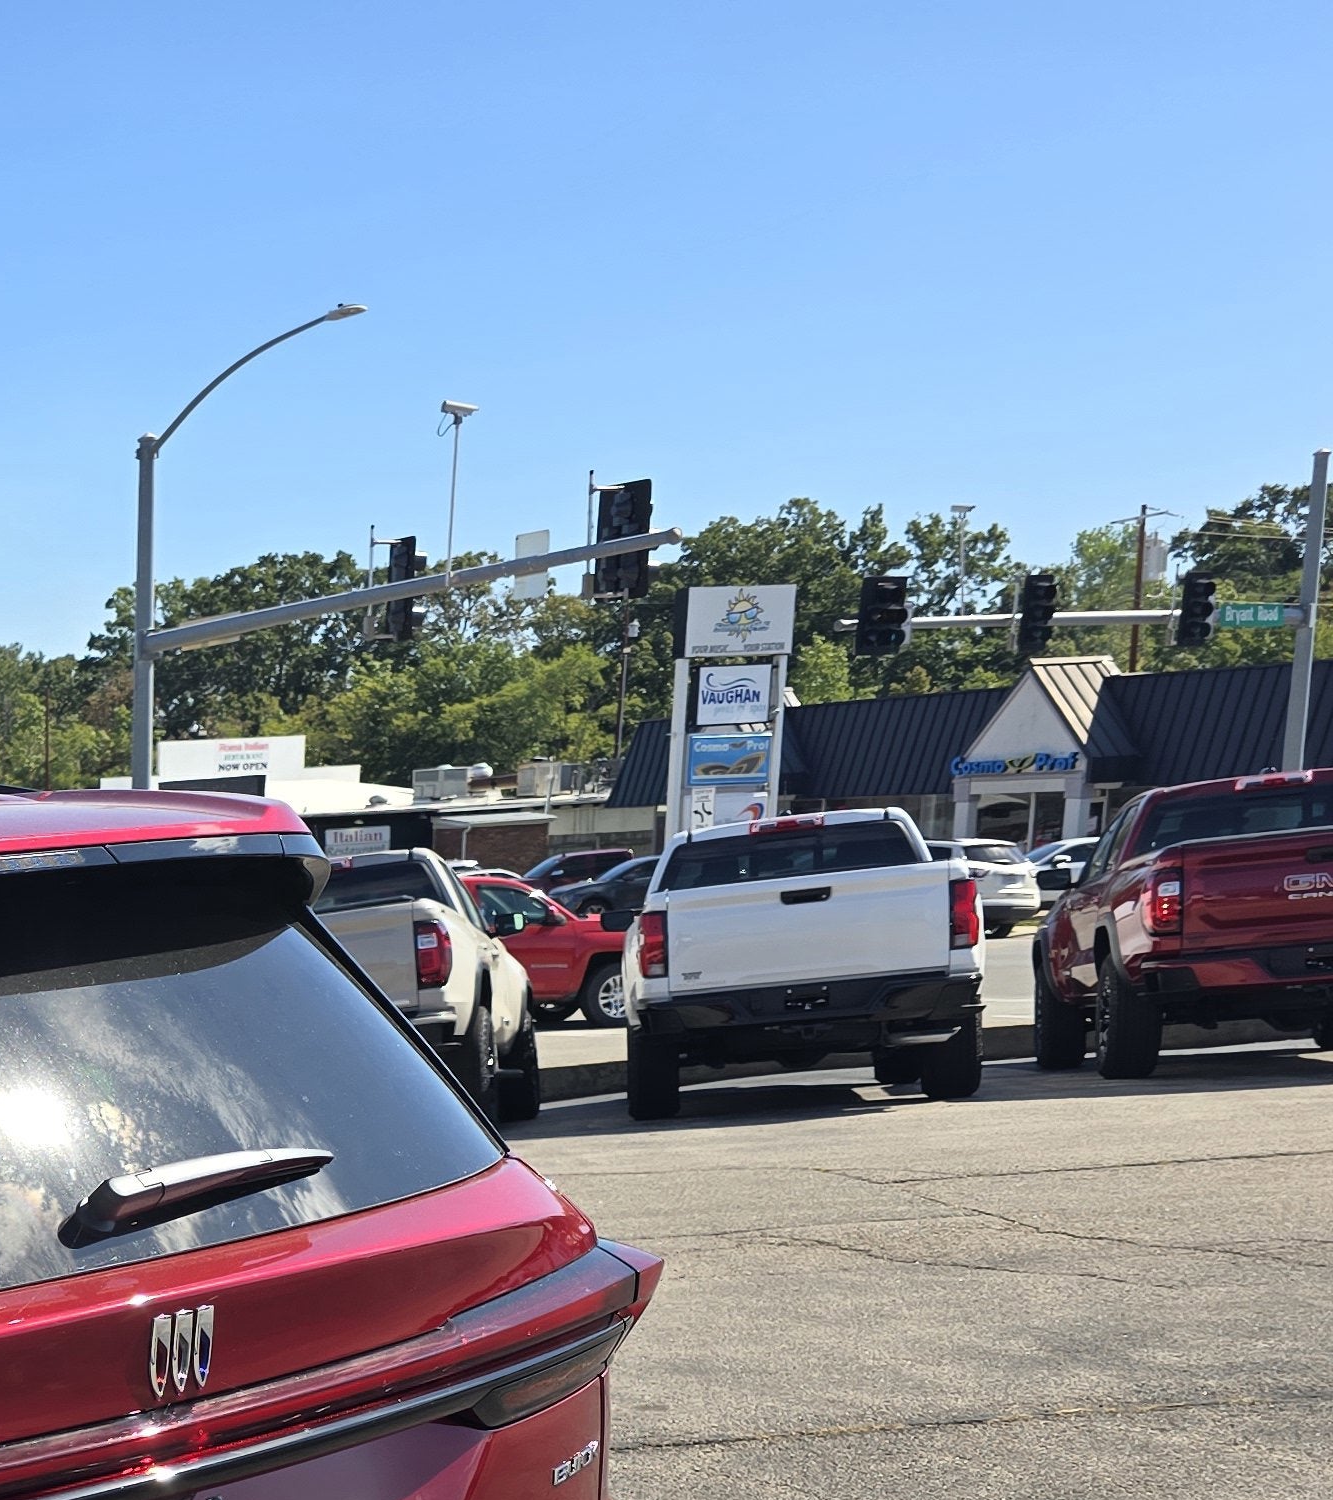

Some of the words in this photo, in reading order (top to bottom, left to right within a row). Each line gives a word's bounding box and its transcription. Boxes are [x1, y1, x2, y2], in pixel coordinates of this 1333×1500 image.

[1225, 606, 1254, 625] Bryant
[1258, 606, 1279, 621] Road
[702, 689, 760, 704] VAUGHAN
[694, 742, 730, 752] Cosmo
[746, 740, 769, 750] Prof
[218, 763, 240, 771] NOW
[243, 762, 268, 770] OPEN
[950, 757, 1006, 775] Cosmo
[1034, 752, 1079, 771] Prof
[334, 830, 383, 843] Italian
